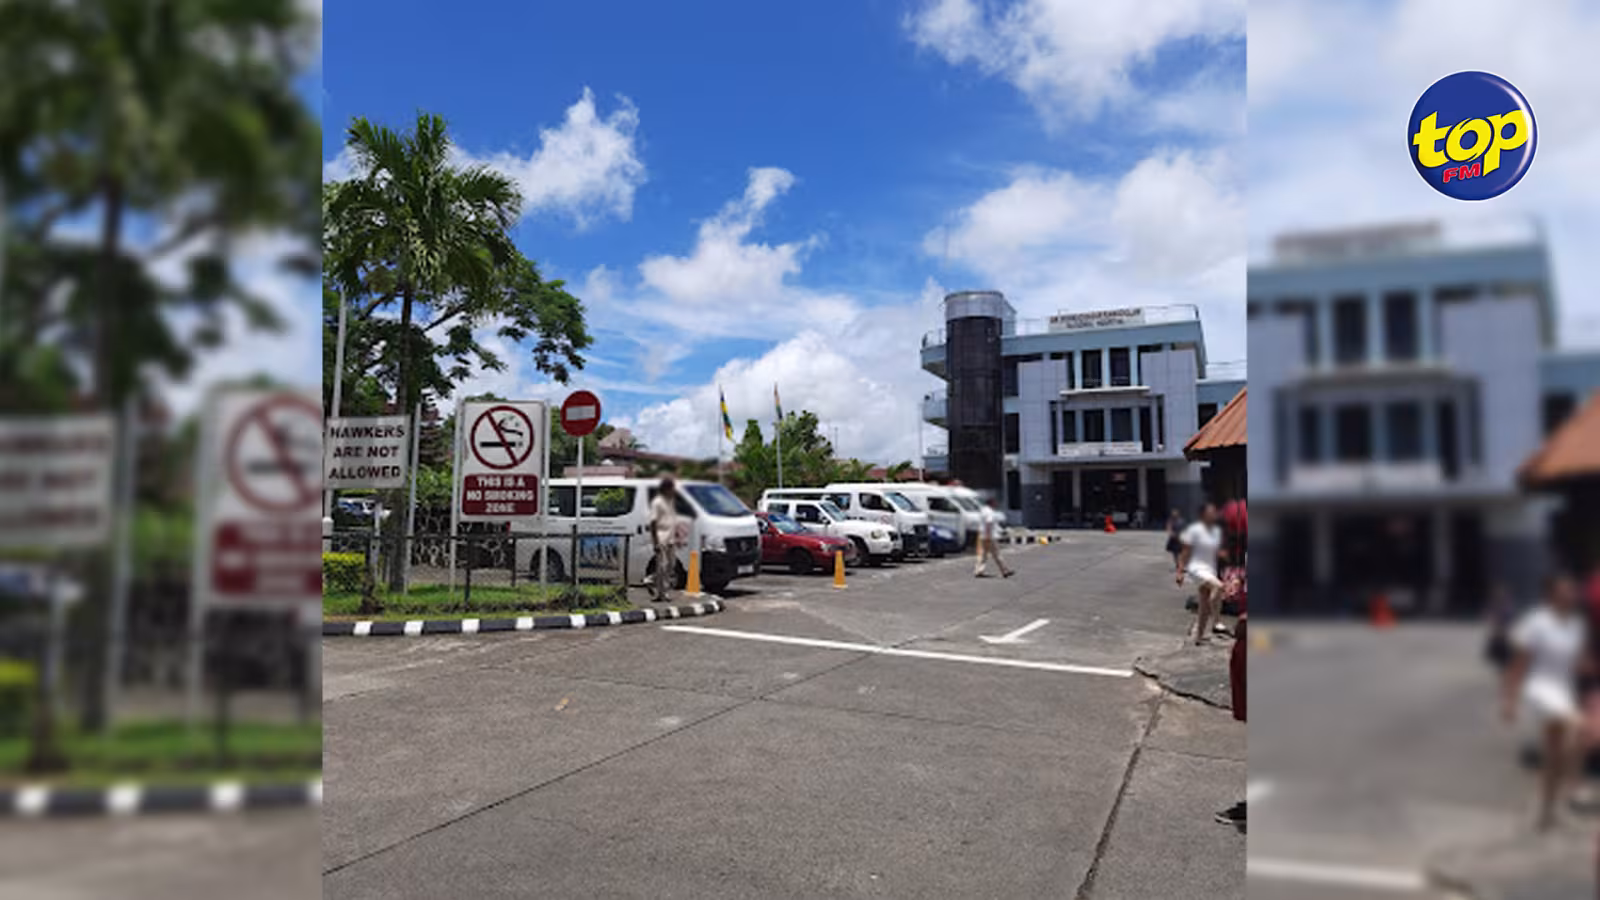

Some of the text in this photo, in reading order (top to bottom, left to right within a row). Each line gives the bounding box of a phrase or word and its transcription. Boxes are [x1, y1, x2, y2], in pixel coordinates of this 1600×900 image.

[330, 425, 405, 438] HAWKERS
[334, 445, 399, 458] ARE NOT
[328, 465, 401, 479] ALLOWED
[477, 476, 525, 487] THIS IS A
[466, 490, 534, 501] NO SMOKING
[485, 503, 516, 513] ZONE
